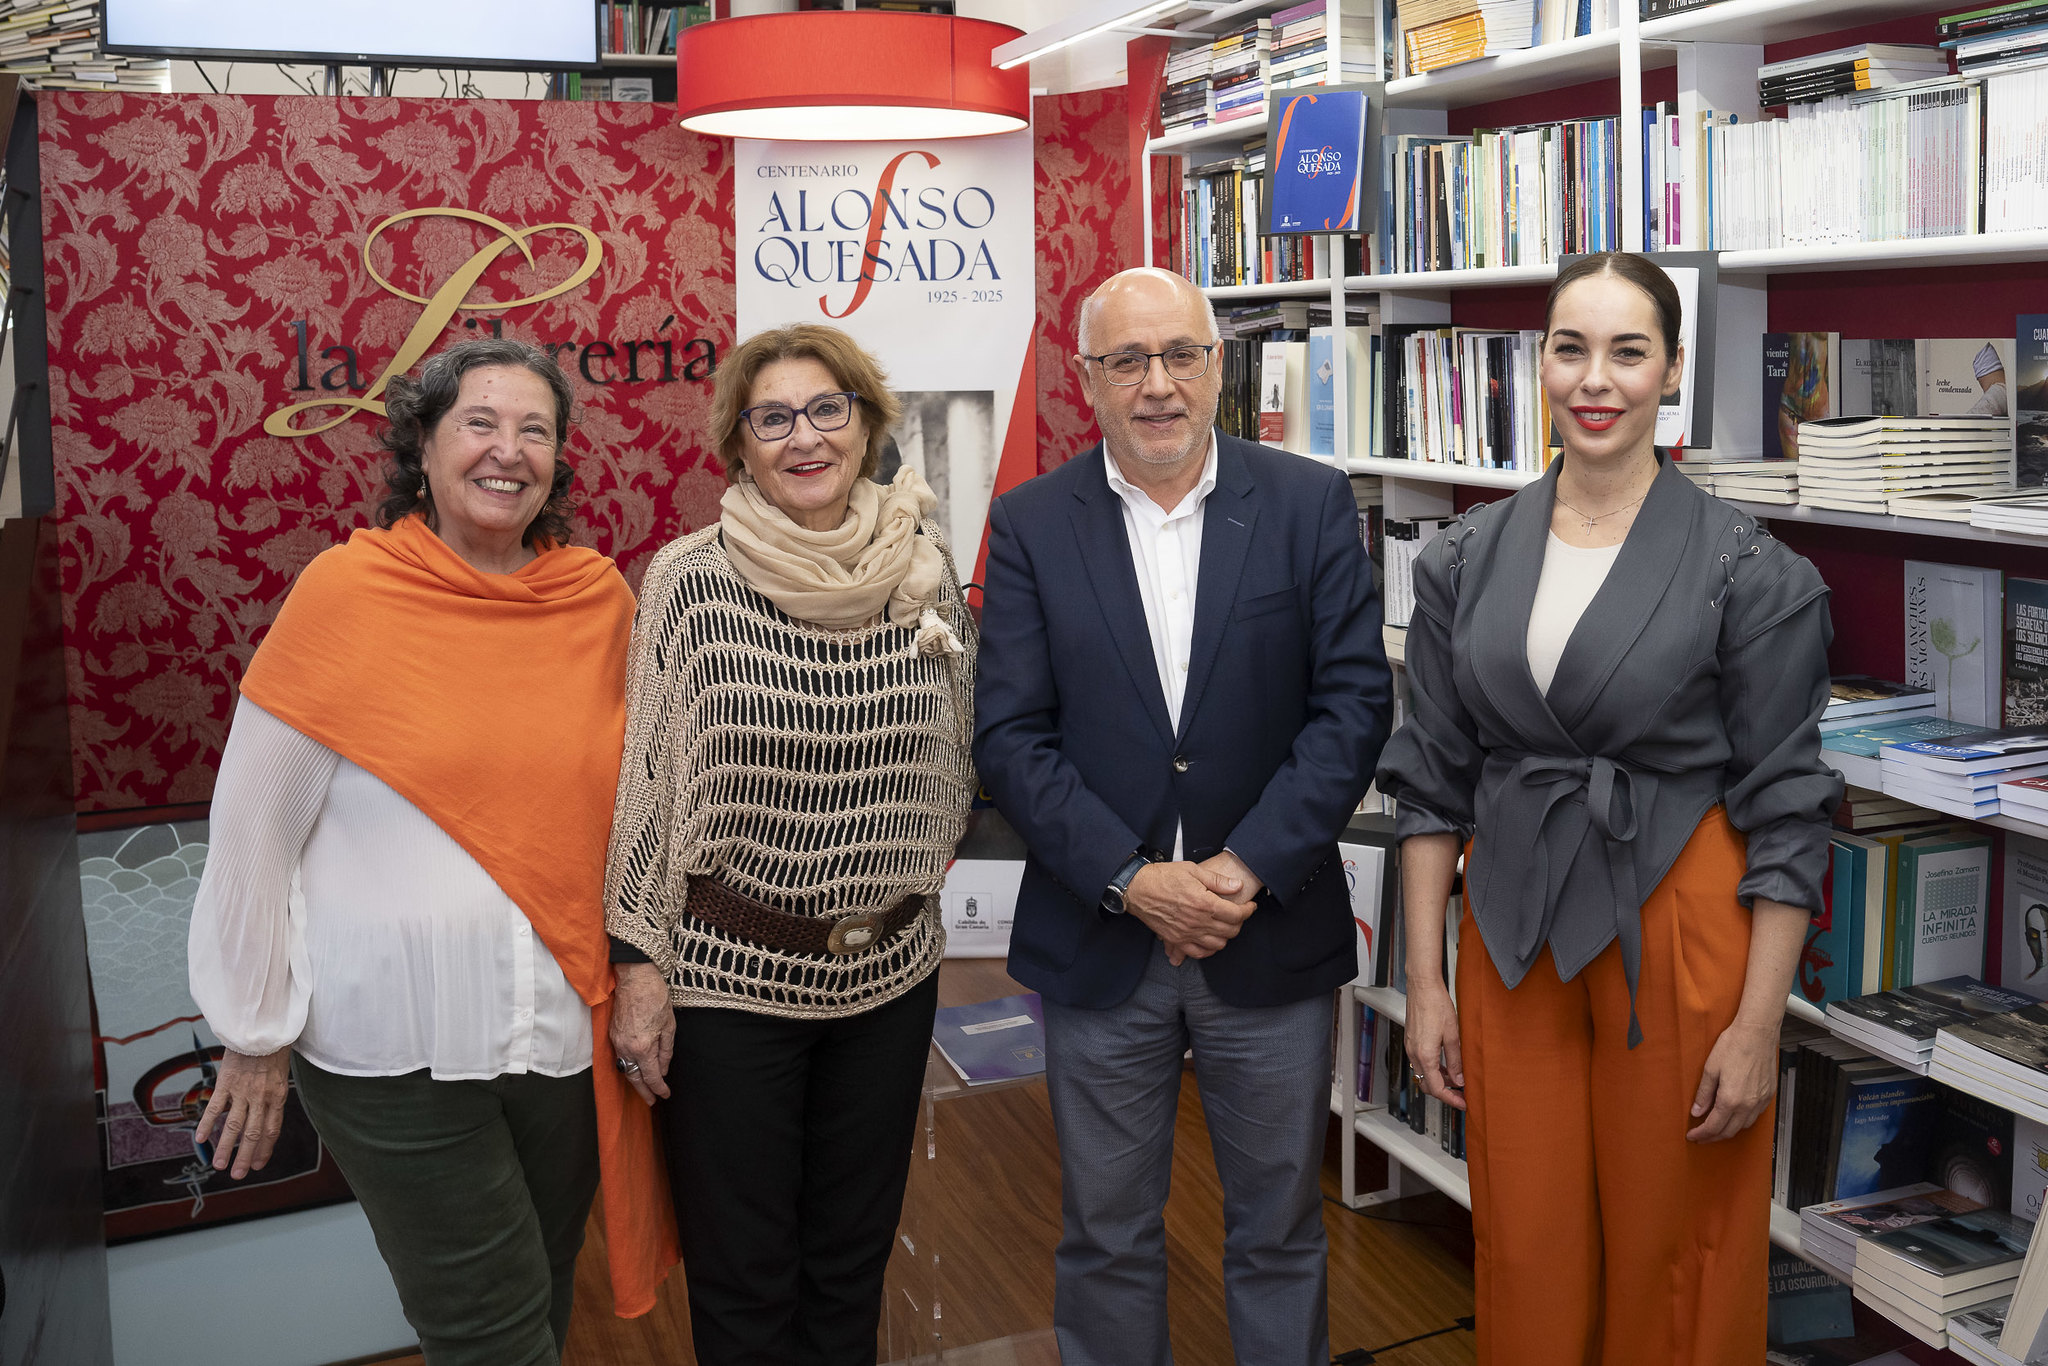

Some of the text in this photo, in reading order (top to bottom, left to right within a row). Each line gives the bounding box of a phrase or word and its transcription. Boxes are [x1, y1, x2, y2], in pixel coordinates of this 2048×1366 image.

[1140, 54, 1163, 131] Novedades
[1299, 152, 1341, 163] ALONSO
[757, 164, 859, 178] CENTENARIO
[1297, 162, 1341, 174] QUESADA
[758, 187, 995, 232] ALONSO
[754, 236, 1001, 288] QUESADA
[927, 291, 958, 303] 1925
[971, 290, 1003, 303] 2025
[291, 320, 366, 391] la
[1766, 348, 1789, 358] vientre
[1766, 365, 1787, 377] Tara
[1939, 386, 1973, 394] condensada
[2016, 603, 2027, 618] LAS
[1909, 586, 1919, 674] GUANCHES
[2016, 616, 2043, 633] SECRETAS
[2016, 628, 2026, 642] LOS
[1925, 866, 1980, 879] Josefina Zamora
[1923, 905, 1978, 923] LA MIRADA
[1922, 917, 1976, 936] INFINITA
[1921, 930, 1977, 945] CUENTOS REUNIDOS
[1858, 1090, 1905, 1102] Volcán islandés
[1856, 1102, 1864, 1111] de
[1865, 1099, 1889, 1109] nombre
[1868, 1114, 1890, 1123] Méndez
[1772, 1263, 1790, 1277] LUZ
[1775, 1280, 1787, 1293] LA
[1789, 1275, 1840, 1291] OSCURIDAD
